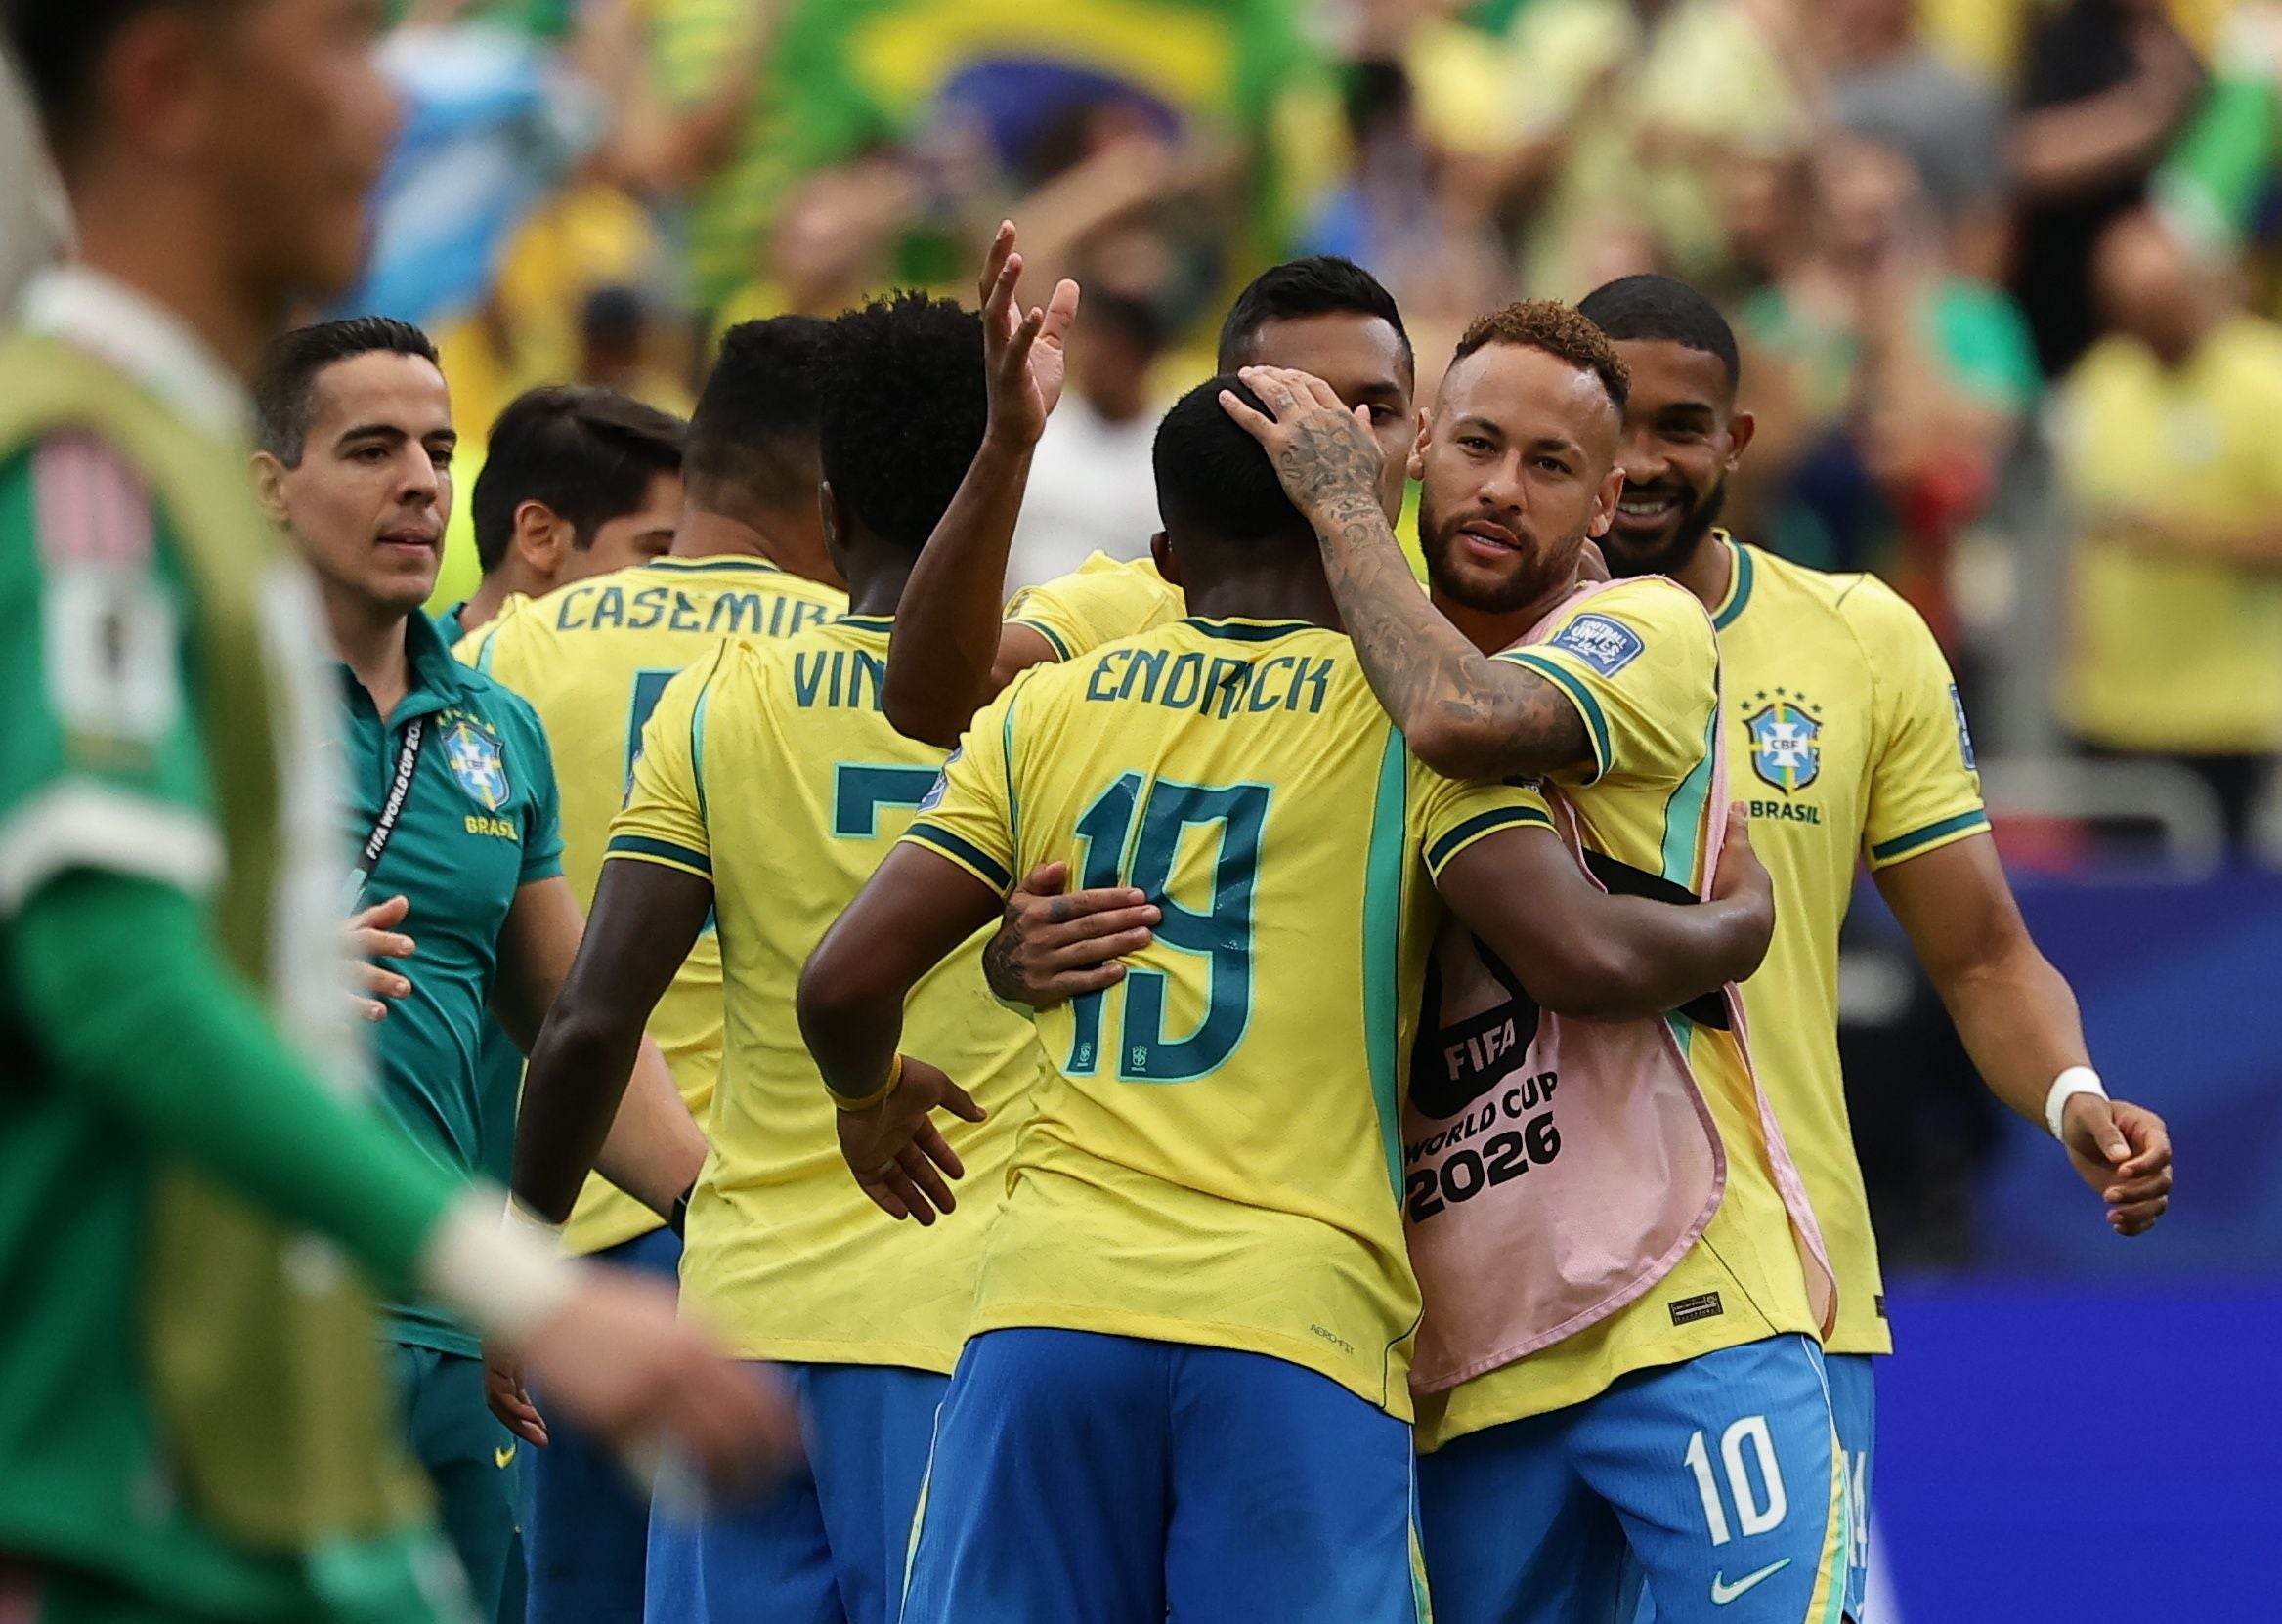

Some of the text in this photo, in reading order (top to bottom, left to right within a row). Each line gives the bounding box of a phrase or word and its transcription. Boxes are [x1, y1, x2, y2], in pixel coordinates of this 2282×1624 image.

[556, 587, 848, 637] CASEMIR
[1572, 625, 1620, 656] UNITES
[1580, 620, 1627, 649] FOOTBALL
[1771, 739, 1799, 750] CBF
[366, 826, 390, 860] FIFA
[379, 775, 409, 828] WORLD
[399, 748, 414, 778] CUP
[464, 815, 519, 841] BRASIL
[1750, 800, 1822, 825] BRASIL
[1061, 769, 1275, 1085] 19
[1443, 1017, 1516, 1082] FIFA
[1405, 1071, 1558, 1166] WORLD CUP
[1405, 1111, 1562, 1223] 2026
[1683, 1414, 1787, 1547] 10
